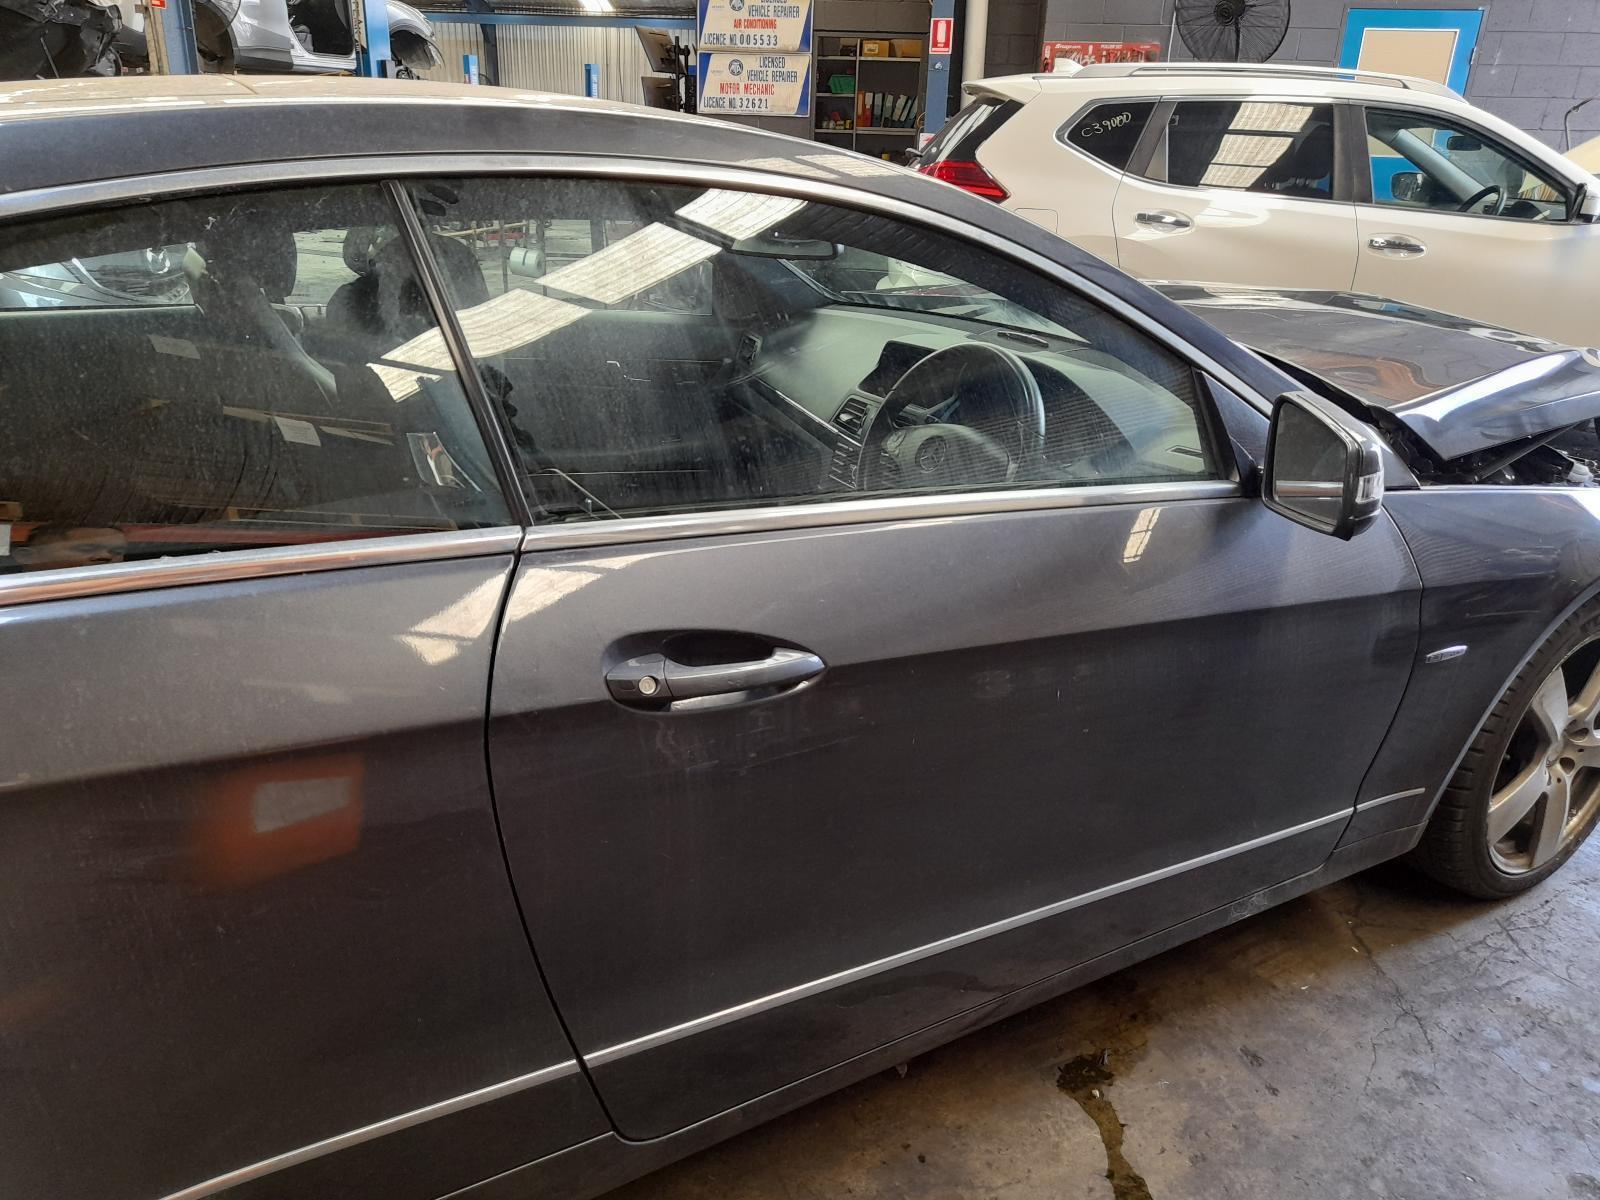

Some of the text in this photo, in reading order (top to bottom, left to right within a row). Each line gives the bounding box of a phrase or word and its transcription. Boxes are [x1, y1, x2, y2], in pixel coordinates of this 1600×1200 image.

[748, 5, 800, 19] VEHICLE REPAIRER
[733, 19, 777, 30] AIR CONDITIONING
[704, 33, 727, 46] LICENCE
[739, 34, 778, 47] 005533
[759, 56, 786, 69] LICENSED
[746, 69, 798, 83] VEHICLE REPAIRER
[719, 82, 775, 96] MOTOR MECHANIC
[703, 96, 726, 109] LICENCE
[738, 97, 769, 110] 32621
